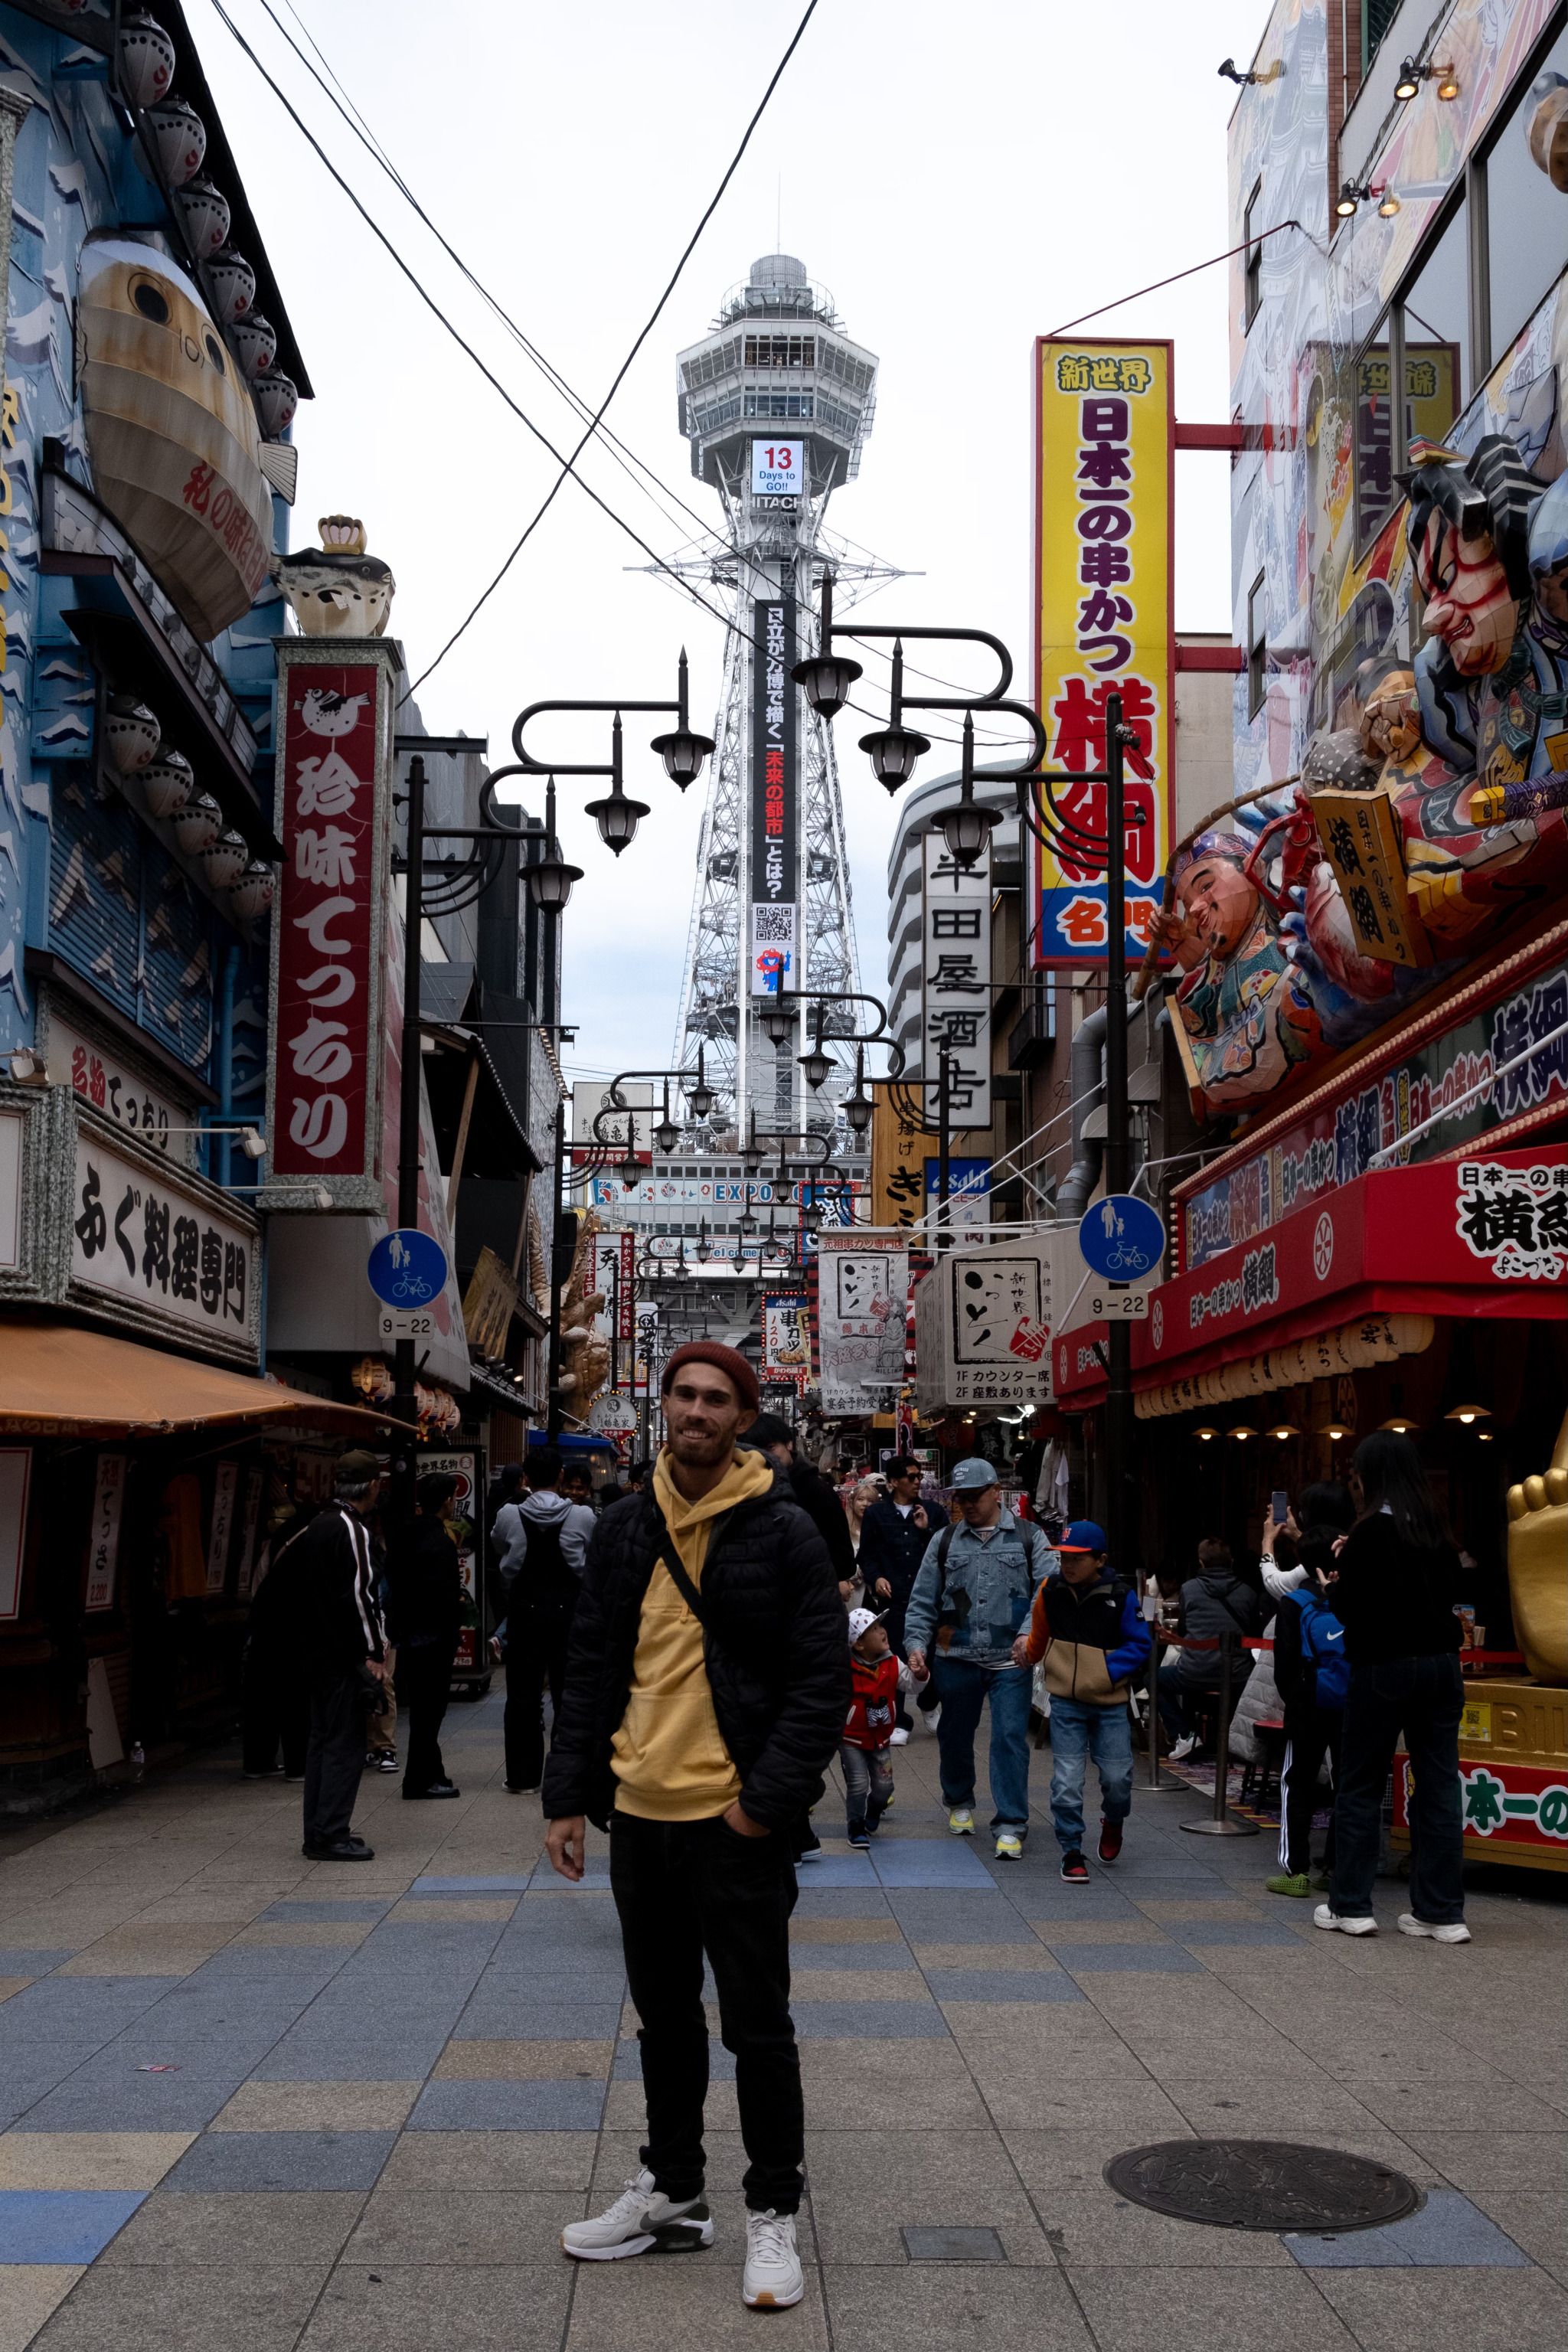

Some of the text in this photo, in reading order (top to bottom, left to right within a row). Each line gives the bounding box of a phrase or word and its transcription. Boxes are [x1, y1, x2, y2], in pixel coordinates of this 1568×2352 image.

[1058, 358, 1151, 393] 新世界
[760, 471, 795, 481] Days to
[764, 447, 792, 470] 13
[748, 497, 808, 509] HITACHI
[1079, 398, 1132, 671] 日本一の串かつ
[1053, 679, 1155, 884] 横綱
[288, 752, 361, 1159] 珍味てっちり
[928, 854, 988, 1109] 半田屋酒店
[72, 1045, 168, 1148] 名物てっちり
[897, 1101, 916, 1156] 串揚げ
[714, 1184, 773, 1202] EXPO
[75, 1161, 246, 1325] ふぐ料理専門
[824, 1238, 904, 1250] 元祖串カツ専門店
[1011, 1272, 1031, 1315] 新世界
[780, 1309, 800, 1352] 串カツ
[956, 1386, 1051, 1399] 2F 座敷あります
[957, 1370, 1050, 1383] 1F カウンター席
